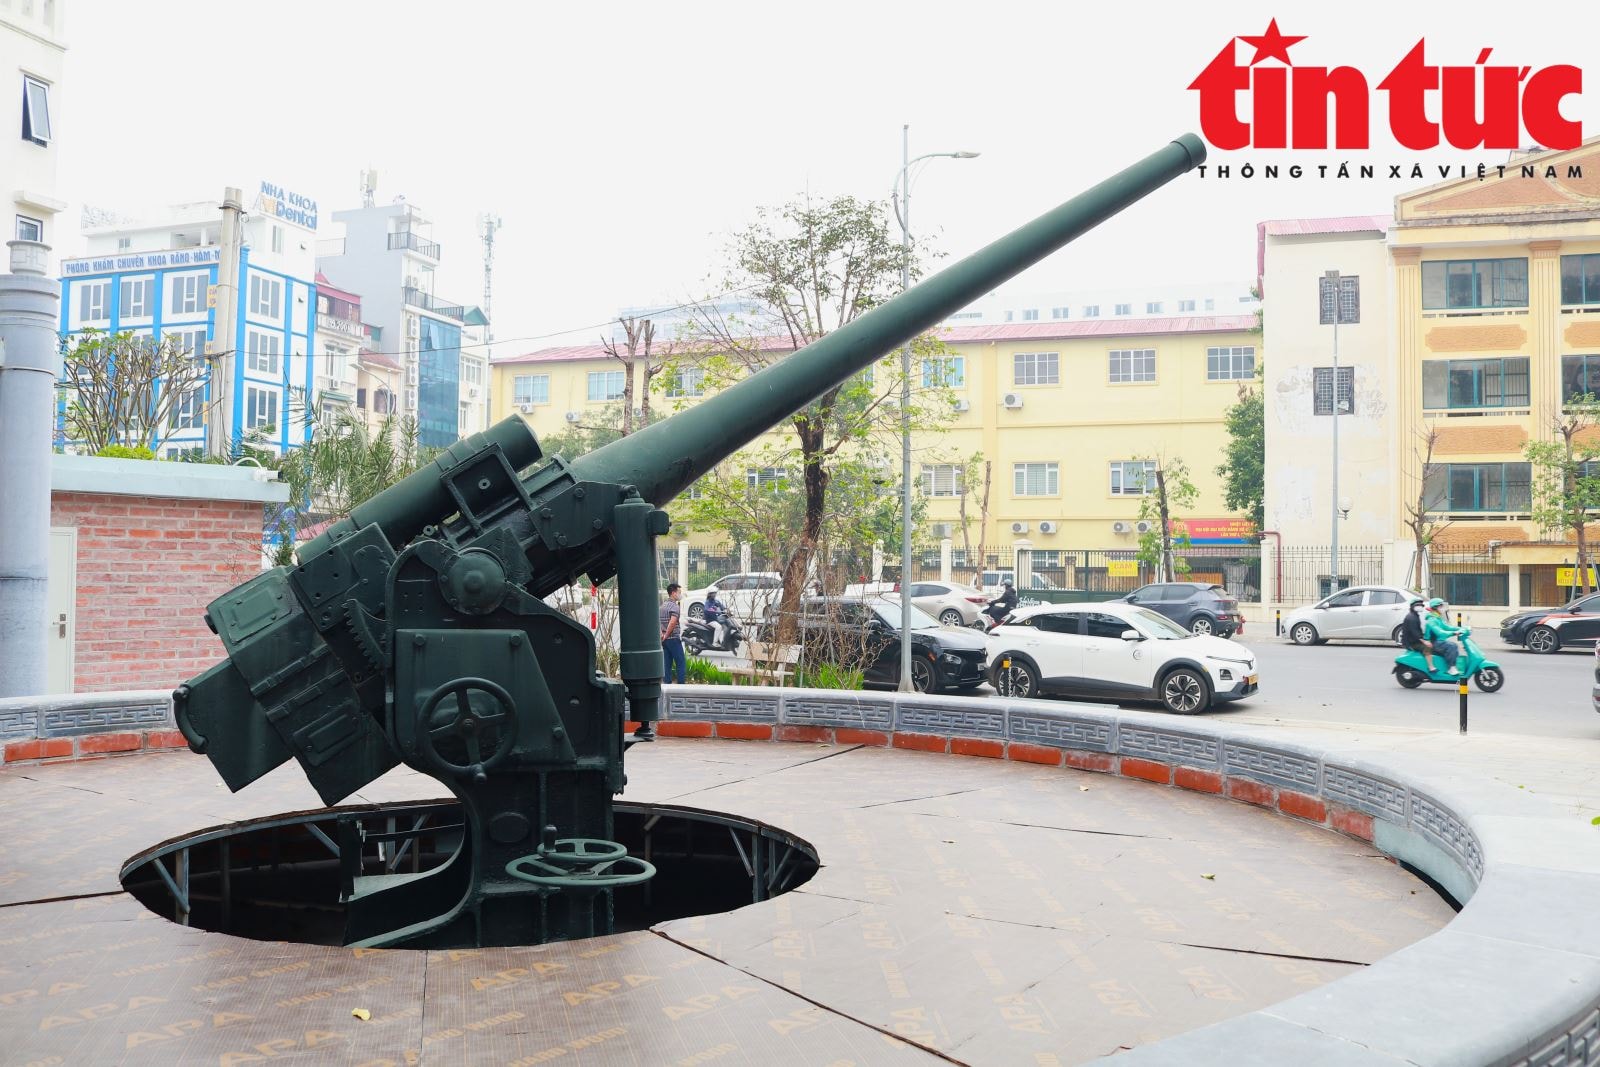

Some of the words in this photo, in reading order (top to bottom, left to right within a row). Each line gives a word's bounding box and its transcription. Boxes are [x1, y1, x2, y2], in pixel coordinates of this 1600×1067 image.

[261, 180, 285, 201] NHA
[289, 191, 317, 213] KHOA
[276, 200, 317, 231] Dental
[469, 961, 568, 992] APA
[563, 973, 662, 1007] APA
[39, 996, 170, 1032] APA
[661, 985, 761, 1021] APA
[126, 1012, 256, 1050] APA
